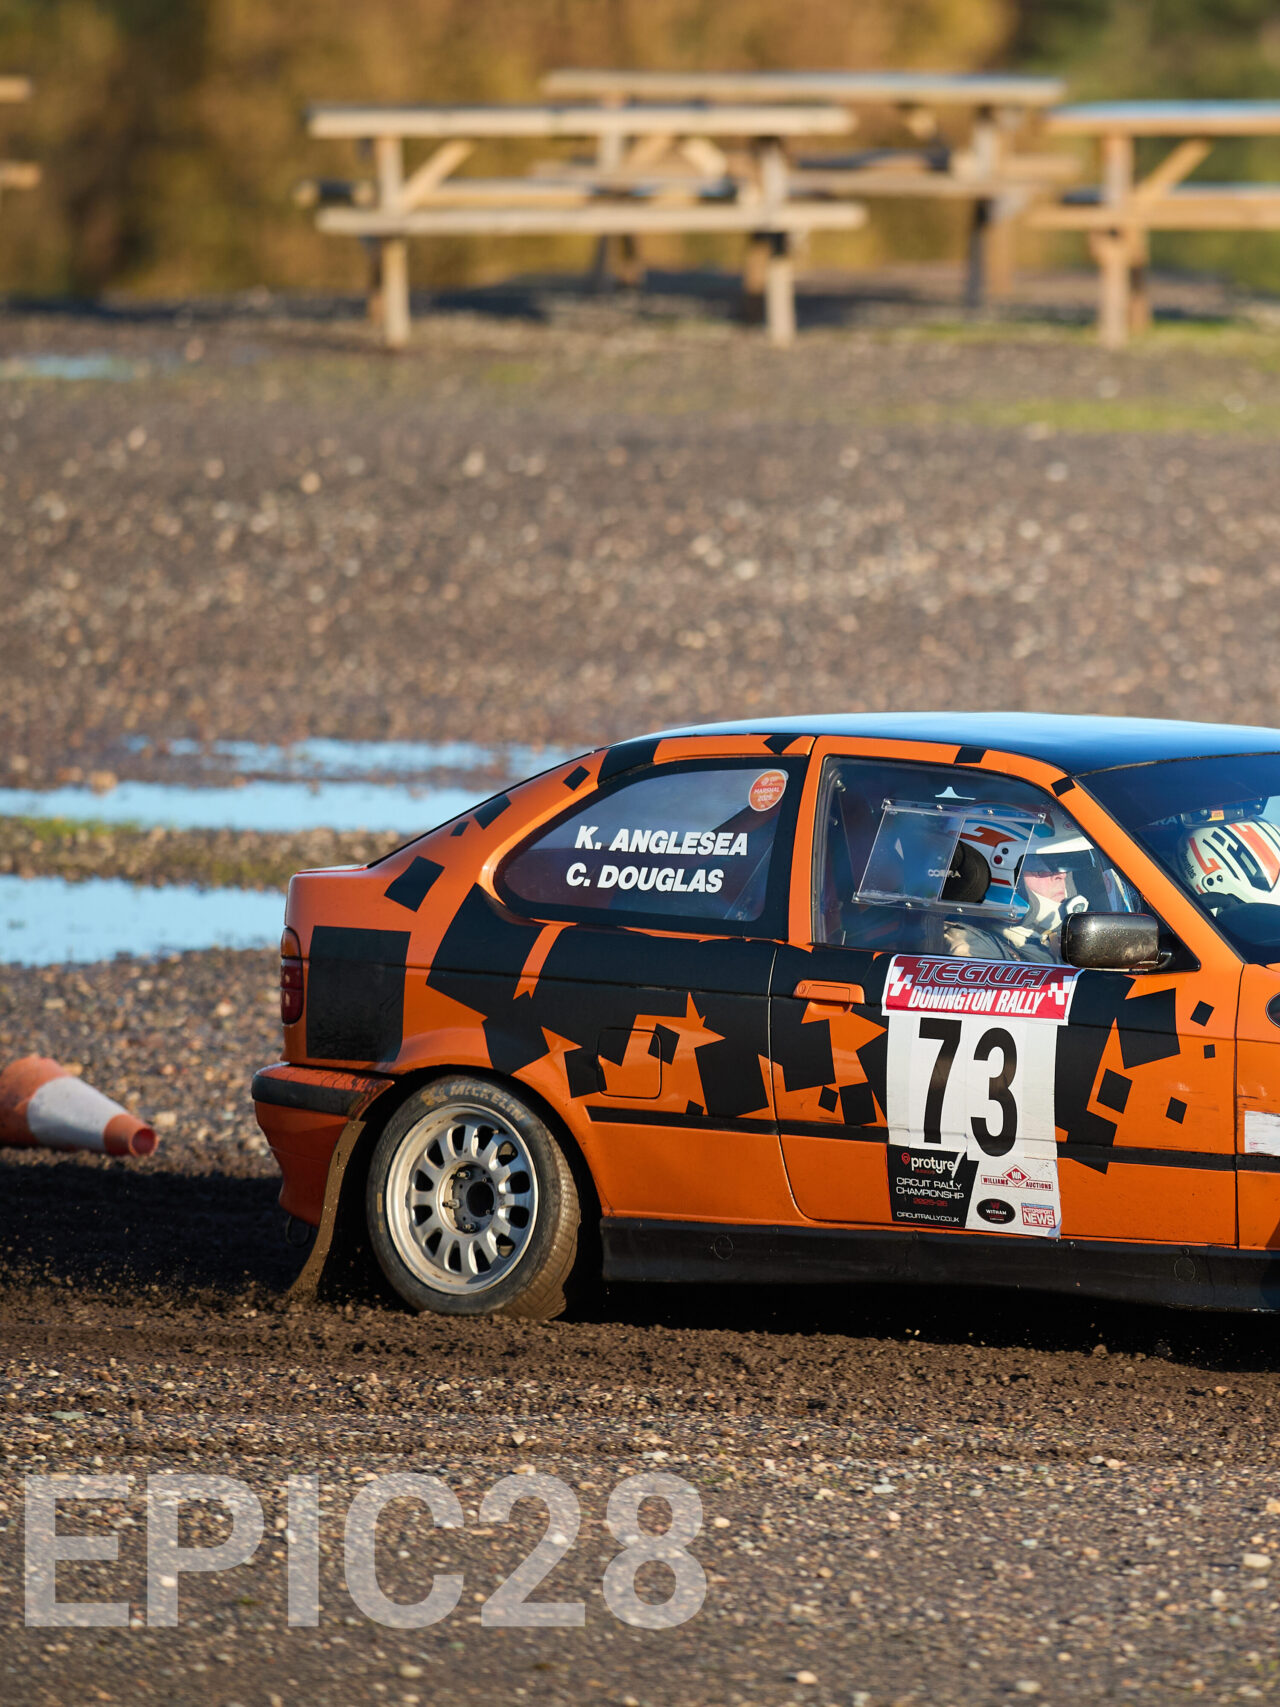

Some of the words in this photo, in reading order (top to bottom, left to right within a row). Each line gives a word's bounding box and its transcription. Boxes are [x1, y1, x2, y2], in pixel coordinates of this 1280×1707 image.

[575, 825, 601, 850] K.
[609, 828, 748, 856] ANGLESEA
[566, 862, 590, 887] C.
[597, 865, 724, 893] DOUGLAS
[917, 959, 1055, 989] TEGIWA
[908, 985, 997, 1012] DONINGTON
[995, 990, 1046, 1015] RALLY
[918, 1017, 1017, 1157] 73
[911, 1157, 954, 1174] protyre
[896, 1177, 931, 1187] CIRCUIT
[933, 1181, 962, 1190] RALLY
[896, 1186, 964, 1200] CHAMPIONSHIP
[983, 1177, 1009, 1186] WILLIAMS
[1025, 1181, 1052, 1190] AUCTIONS
[1023, 1212, 1054, 1226] NEWS
